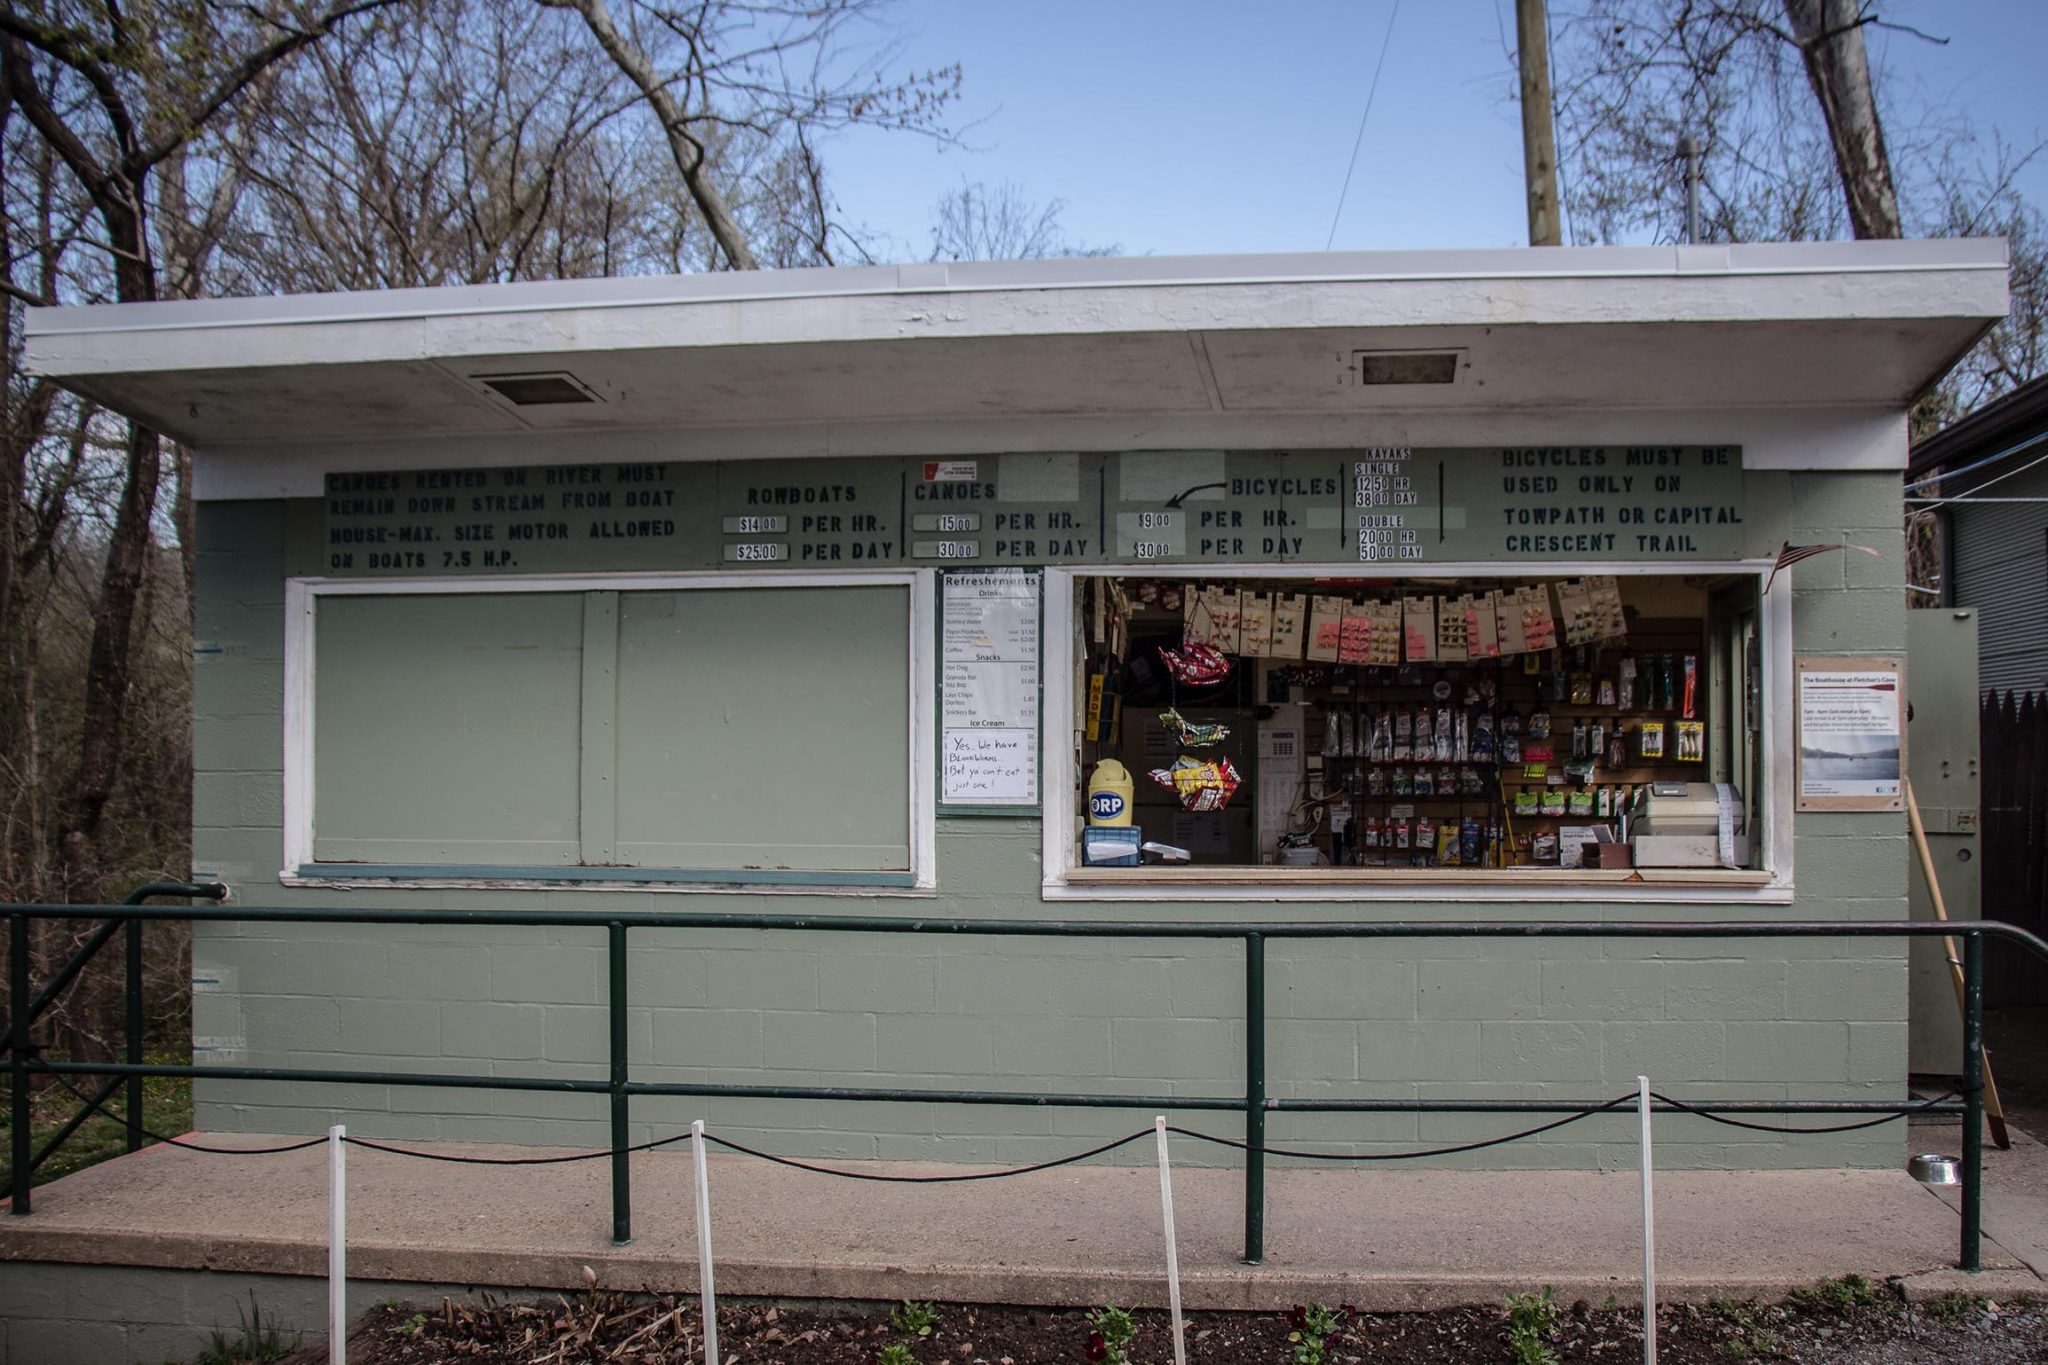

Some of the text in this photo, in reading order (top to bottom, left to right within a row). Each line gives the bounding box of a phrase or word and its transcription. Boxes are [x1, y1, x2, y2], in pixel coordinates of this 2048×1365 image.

[1367, 448, 1410, 459] KAYAKS
[1503, 448, 1729, 467] BICYCLES MUST BE
[329, 465, 667, 491] CANOES RENTED ON RIVER MUST
[1356, 463, 1398, 475] SINGLE
[914, 482, 996, 501] CANOES
[1231, 478, 1336, 496] BICYCLES
[1503, 475, 1681, 494] USED ONLY ON
[330, 490, 675, 515] REMAIN DOWN STREAM FROM BOAT
[747, 485, 857, 504] ROWBOATS
[1396, 493, 1416, 504] DAY
[802, 515, 841, 532] PER
[852, 514, 886, 532] HR.
[995, 512, 1036, 530] PER
[1048, 512, 1082, 529] HR.
[1200, 511, 1242, 528] PER
[1263, 510, 1297, 526] HR.
[1360, 516, 1402, 527] DOUBLE
[1504, 506, 1742, 525] TOWPATH OR CAPITAL
[455, 524, 494, 541] SIZE
[508, 523, 569, 540] MOTOR
[590, 520, 675, 538] ALLOWED
[802, 543, 841, 560] PER
[852, 542, 893, 559] DAY
[995, 540, 1036, 557] PER
[1049, 539, 1088, 556] DAY
[1200, 538, 1244, 555] PER
[1263, 537, 1303, 555] DAY
[1506, 532, 1697, 552] CRESCENT TRAIL
[331, 550, 518, 568] ON BOATS 7.5 H.P.
[1401, 546, 1421, 558] DAY
[976, 653, 1001, 661] Snacks
[981, 719, 1005, 727] Cream
[953, 737, 970, 751] Yes
[995, 739, 1018, 749] have
